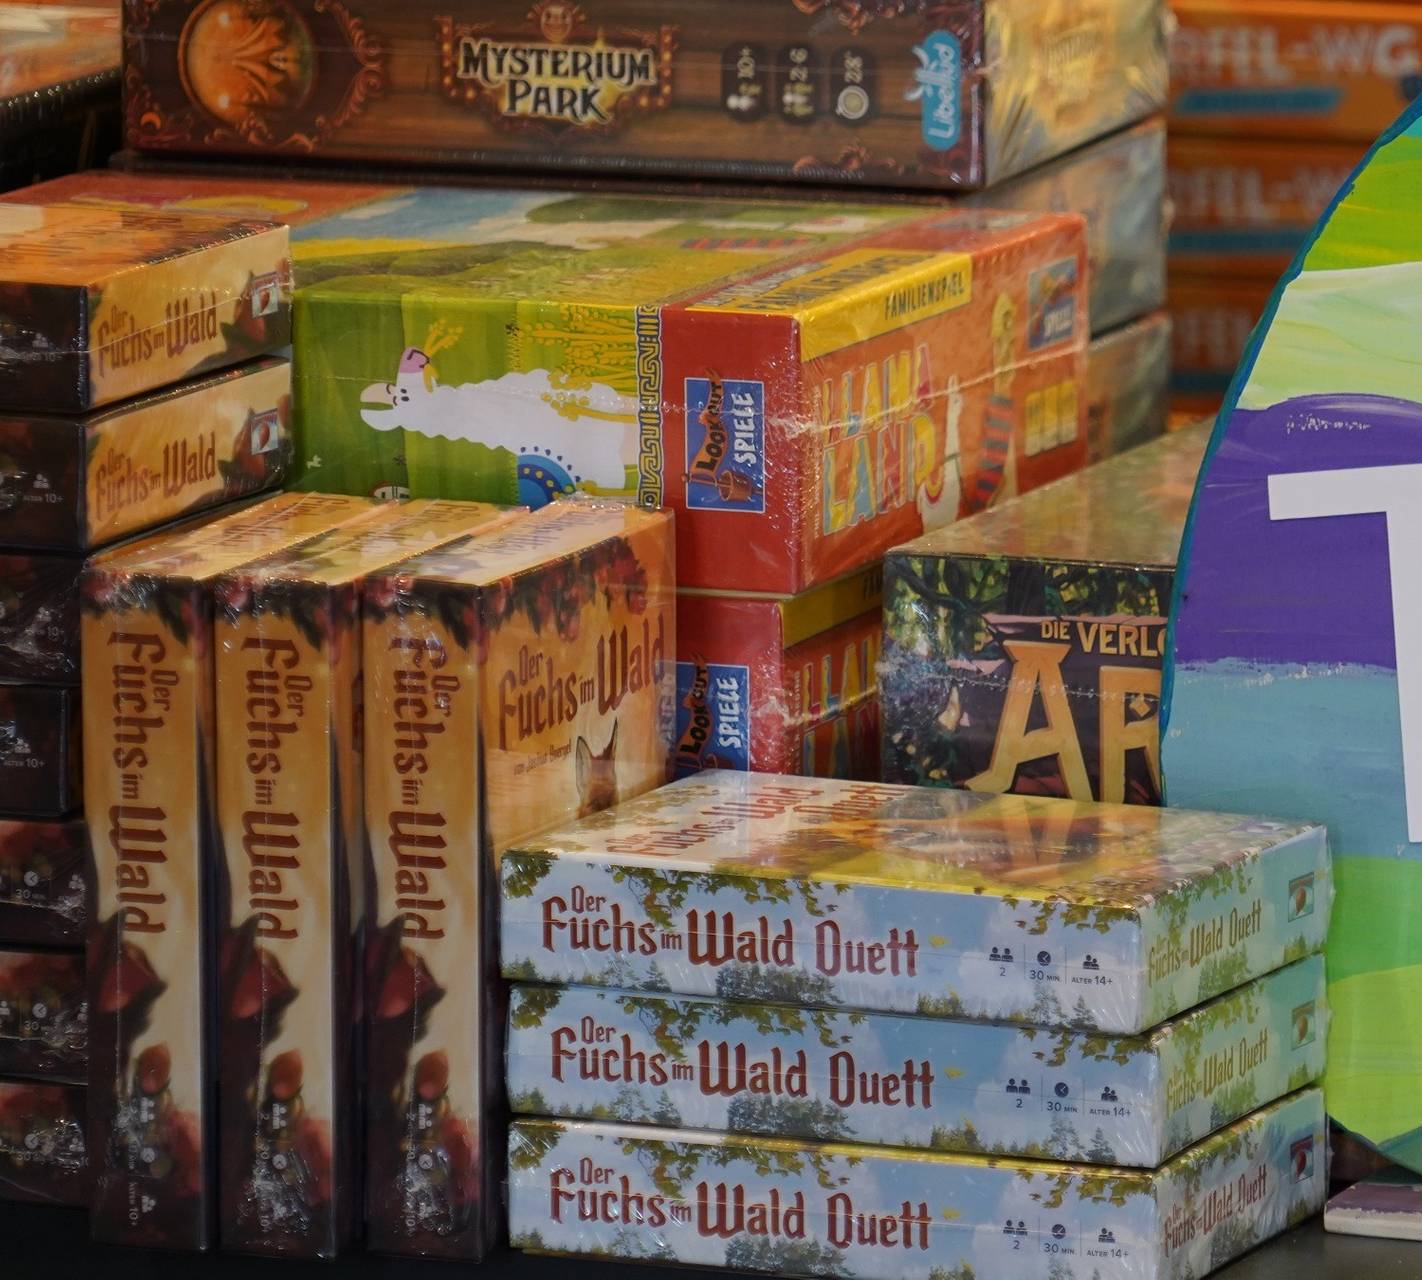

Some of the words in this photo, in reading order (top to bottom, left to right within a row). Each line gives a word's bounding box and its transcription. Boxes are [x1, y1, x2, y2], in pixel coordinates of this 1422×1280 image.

[460, 40, 653, 86] MYSTERIUM
[507, 79, 609, 121] PARK
[927, 42, 955, 139] Libellud
[884, 270, 965, 321] FAMILIENSPIEL
[97, 316, 152, 378] Fuchs
[165, 291, 218, 359] Wald
[110, 305, 128, 332] Der
[730, 392, 757, 466] SPIELE
[96, 455, 149, 521] Fuchs
[163, 431, 216, 499] Wald
[108, 447, 126, 475] Der
[1041, 620, 1071, 640] DIE
[499, 656, 578, 752] Fuchs
[578, 674, 595, 703] im
[597, 612, 666, 717] Wald
[519, 644, 544, 687] Der
[107, 631, 167, 769] Fuchs
[150, 669, 180, 713] Der
[240, 636, 299, 775] Fuchs
[284, 674, 314, 717] Der
[388, 636, 448, 775] Fuchs
[431, 674, 461, 718] Der
[716, 676, 742, 749] SPIELE
[122, 773, 144, 800] im
[254, 778, 276, 806] im
[401, 778, 424, 806] im
[109, 804, 168, 934] Wald
[242, 810, 301, 940] Wald
[389, 810, 449, 941] Wald
[571, 885, 607, 914] Der
[541, 895, 658, 956] Fuchs
[656, 928, 683, 951] im
[686, 908, 795, 967] Wald
[815, 919, 920, 978] Duett
[1189, 915, 1224, 969] Wald
[1229, 898, 1263, 948] Duett
[999, 966, 1006, 977] 2
[1029, 969, 1045, 981] 30
[1071, 977, 1093, 985] ALTER
[1094, 976, 1113, 987] 14+
[580, 1015, 616, 1045] Der
[550, 1026, 669, 1087] Fuchs
[671, 1059, 694, 1082] im
[697, 1039, 807, 1098] Wald
[829, 1050, 935, 1109] Duett
[1202, 1044, 1234, 1098] Wald
[1239, 1028, 1269, 1078] Duett
[1015, 1098, 1023, 1109] 2
[1047, 1101, 1062, 1112] 30
[1089, 1108, 1111, 1116] ALTER
[1112, 1106, 1131, 1117] 14+
[579, 1156, 616, 1186] Der
[550, 1167, 668, 1229] Fuchs
[669, 1200, 693, 1223] im
[696, 1180, 807, 1240] Wald
[826, 1191, 933, 1251] Duett
[1162, 1208, 1197, 1258] Fuchs
[1202, 1182, 1234, 1236] Wald
[1238, 1163, 1268, 1214] Duett
[1012, 1239, 1020, 1250] 2
[1043, 1243, 1059, 1254] 30
[1110, 1248, 1129, 1258] 14+
